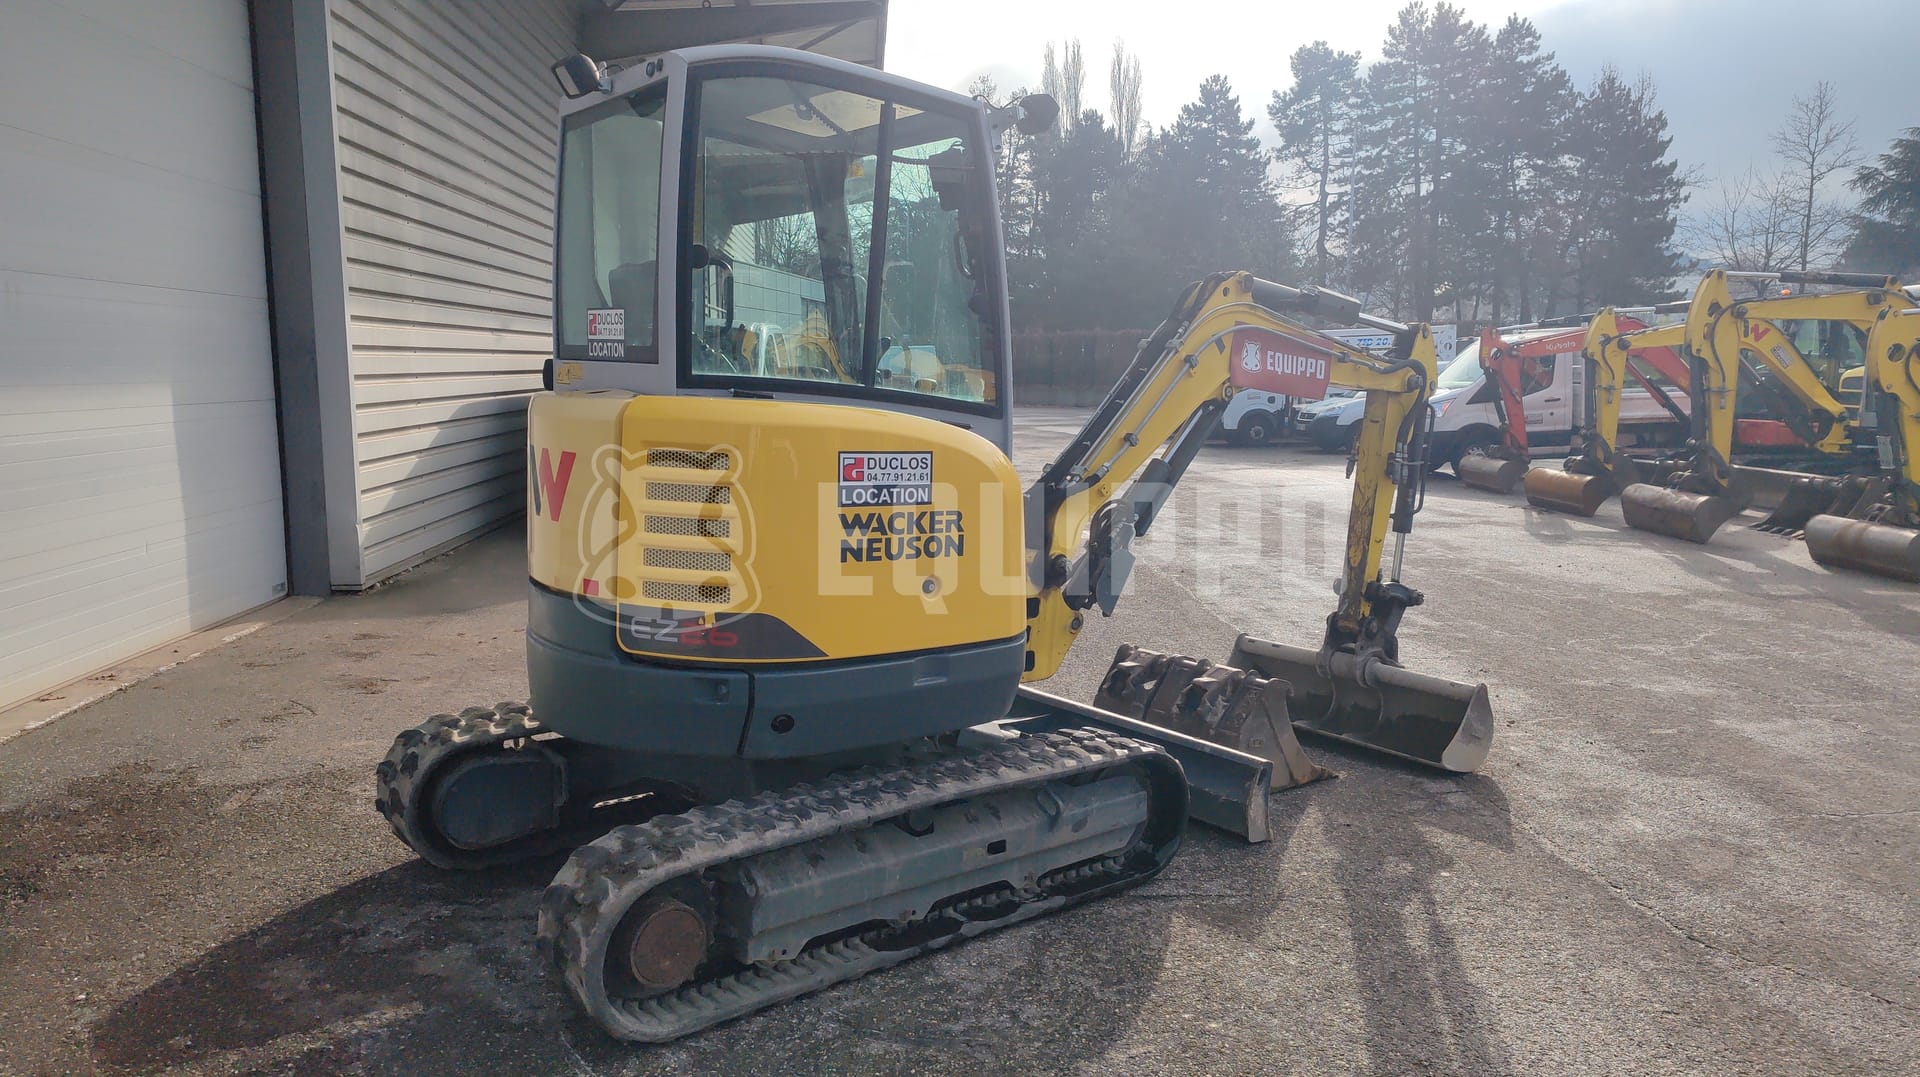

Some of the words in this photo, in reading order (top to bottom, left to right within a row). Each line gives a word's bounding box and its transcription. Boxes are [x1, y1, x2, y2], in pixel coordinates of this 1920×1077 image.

[598, 312, 624, 325] DUCLOS
[588, 341, 624, 358] LOCATION
[1266, 350, 1326, 380] EQUIPPO
[866, 457, 929, 470] DUCLOS
[866, 472, 930, 482] 04.77.91.21.61
[841, 487, 929, 504] LOCATION
[838, 511, 964, 537] WACKER
[840, 534, 964, 562] NEUSON
